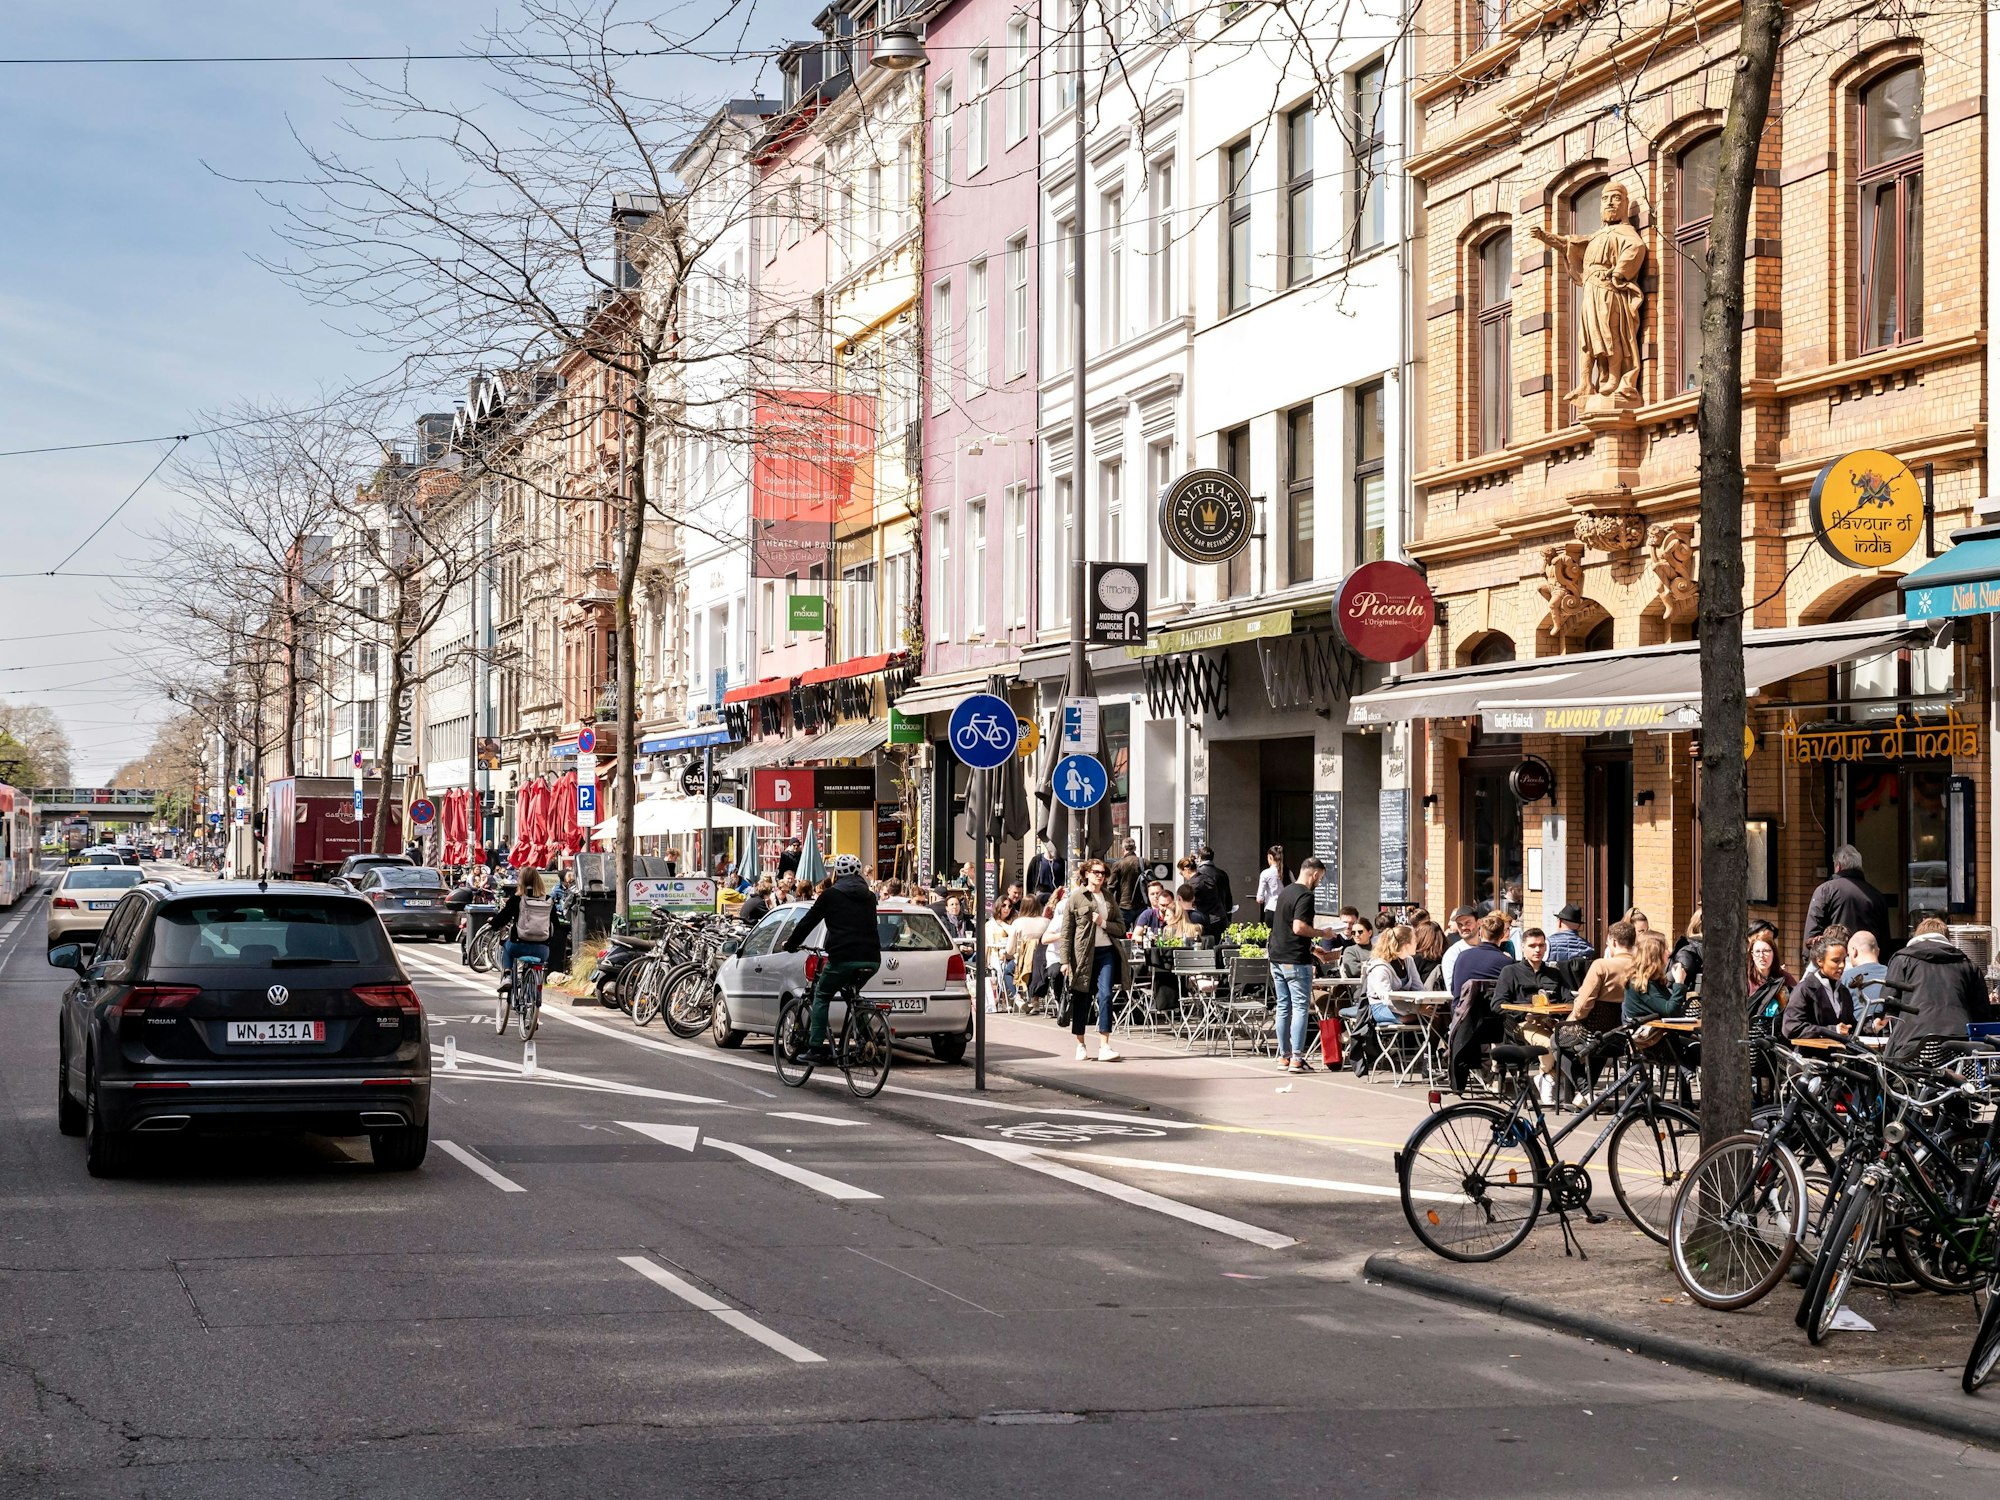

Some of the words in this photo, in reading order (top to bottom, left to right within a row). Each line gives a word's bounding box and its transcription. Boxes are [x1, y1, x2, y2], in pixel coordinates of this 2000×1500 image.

[1178, 483, 1242, 519] BALTHASAR
[1832, 510, 1892, 532] flavour
[1897, 514, 1913, 531] of
[815, 541, 855, 550] BAUTURM
[1194, 539, 1205, 547] BAR
[1206, 528, 1236, 548] RESTAURANT
[1854, 536, 1892, 554] india
[1349, 592, 1424, 618] Piccola
[1952, 583, 1977, 612] Nish
[1096, 622, 1123, 630] ASIATISCHE
[1099, 613, 1123, 621] MODERNE
[1107, 631, 1123, 640] KÜCHE
[1180, 627, 1222, 647] BALTHASAR
[1544, 709, 1601, 729] FLAVOUR
[1605, 708, 1622, 727] OF
[1624, 705, 1664, 725] INDIA
[1784, 713, 1872, 764] flavour
[1880, 714, 1906, 759] of
[1915, 704, 1980, 761] india
[685, 775, 719, 784] SALN
[580, 788, 590, 808] P
[900, 1000, 921, 1009] 1621
[237, 1024, 257, 1038] WN
[268, 1024, 297, 1038] 131
[302, 1024, 311, 1038] A
